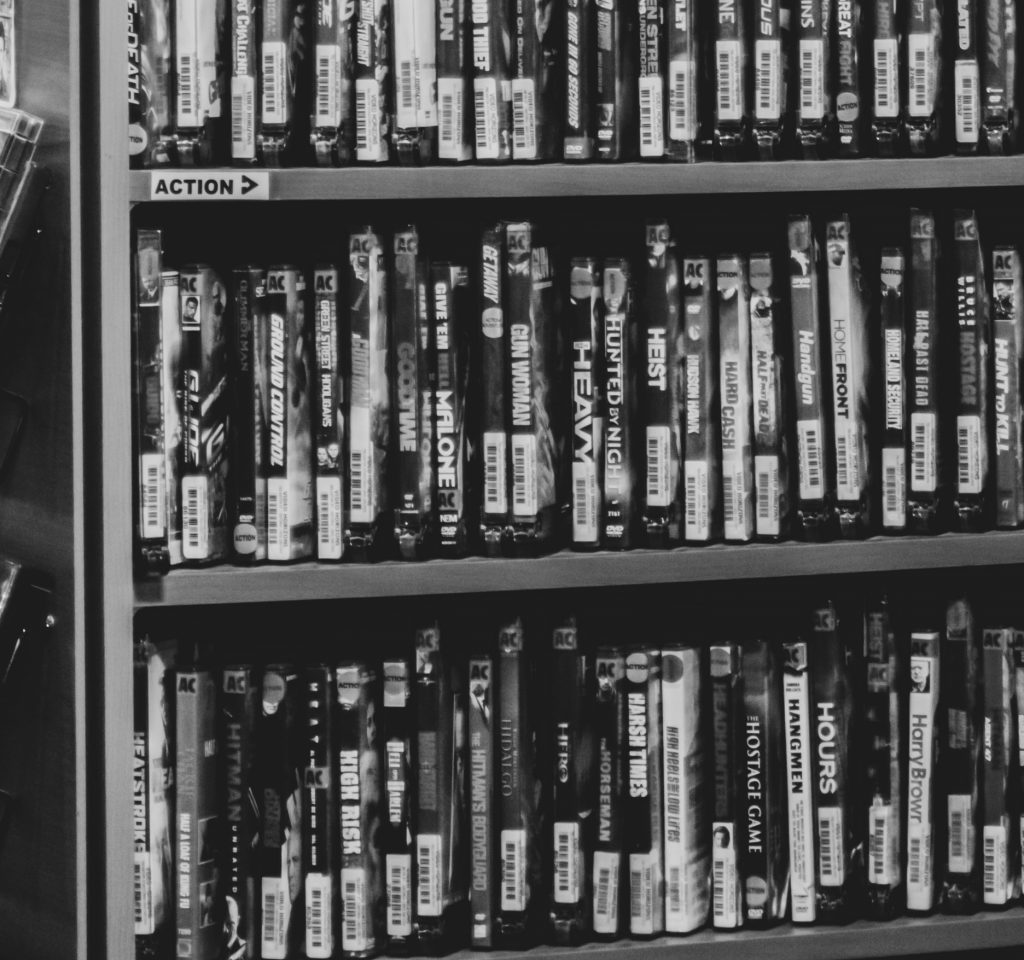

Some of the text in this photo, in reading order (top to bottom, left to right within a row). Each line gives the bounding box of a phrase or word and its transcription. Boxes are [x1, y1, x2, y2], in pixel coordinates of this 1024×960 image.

[356, 23, 371, 67] STRAIGHT
[516, 10, 525, 28] ON
[568, 11, 580, 43] GONE
[473, 26, 491, 72] THIEF
[568, 44, 580, 57] IN
[568, 58, 580, 74] 60
[839, 40, 853, 86] FIGHT
[568, 75, 580, 129] SECONDS
[837, 102, 858, 111] ACTION
[155, 177, 234, 196] ACTION
[181, 276, 198, 293] AC
[268, 276, 286, 293] AC
[315, 275, 333, 292] AC
[482, 244, 500, 304] GETAWAY
[684, 262, 703, 279] AC
[994, 254, 1011, 270] AC
[238, 279, 250, 372] GLIMMER MAN
[957, 276, 965, 327] WILLIS
[965, 275, 976, 327] BRUCE
[319, 300, 333, 428] GREEN STREET HOOLIGANS
[434, 282, 456, 489] GIVE 'EM HELL MALONE
[510, 324, 531, 426] GUN WOMAN
[647, 328, 667, 391] HEIST
[756, 350, 769, 382] HALF
[797, 330, 816, 405] Handgun
[885, 329, 903, 430] HOMELAND SECURITY
[915, 310, 930, 406] HALF PAST DEAD
[960, 331, 976, 406] HOSTAGE
[270, 314, 285, 467] GROUND CONTROL
[398, 342, 417, 452] GOOD TIME
[573, 340, 592, 463] HEAVY
[605, 317, 623, 494] HUNTED BY NIGHT
[686, 354, 702, 435] HUDSON HAWK
[721, 361, 740, 450] HARD CASH
[757, 400, 770, 436] DEAD
[995, 338, 1009, 456] HUNT TO KILL
[188, 411, 200, 467] JOE
[235, 534, 256, 542] ACTION
[178, 675, 196, 693] AC
[471, 661, 489, 681] AC
[596, 661, 615, 679] AC
[500, 719, 514, 797] HIDALGO
[558, 722, 569, 784] HERO
[627, 692, 648, 798] HARSH TIMES
[712, 683, 728, 817] HEADHUNTERS
[788, 698, 803, 794] HANGMEN
[817, 702, 837, 794] HOURS
[907, 713, 929, 765] Harry
[134, 731, 146, 853] HEATSTROKE
[227, 723, 242, 823] HITMAN
[386, 741, 405, 825] HELL HARLEM
[598, 750, 613, 842] HORSEMAN
[746, 721, 763, 854] HOSTAGE GAME
[179, 813, 191, 833] HALF
[340, 750, 362, 855] HIGH RISK
[471, 732, 488, 892] THE HITMAN'S BODYGUARD
[179, 841, 191, 861] LOAF
[179, 862, 191, 873] OF
[179, 874, 191, 897] KUNG
[179, 897, 191, 909] FU
